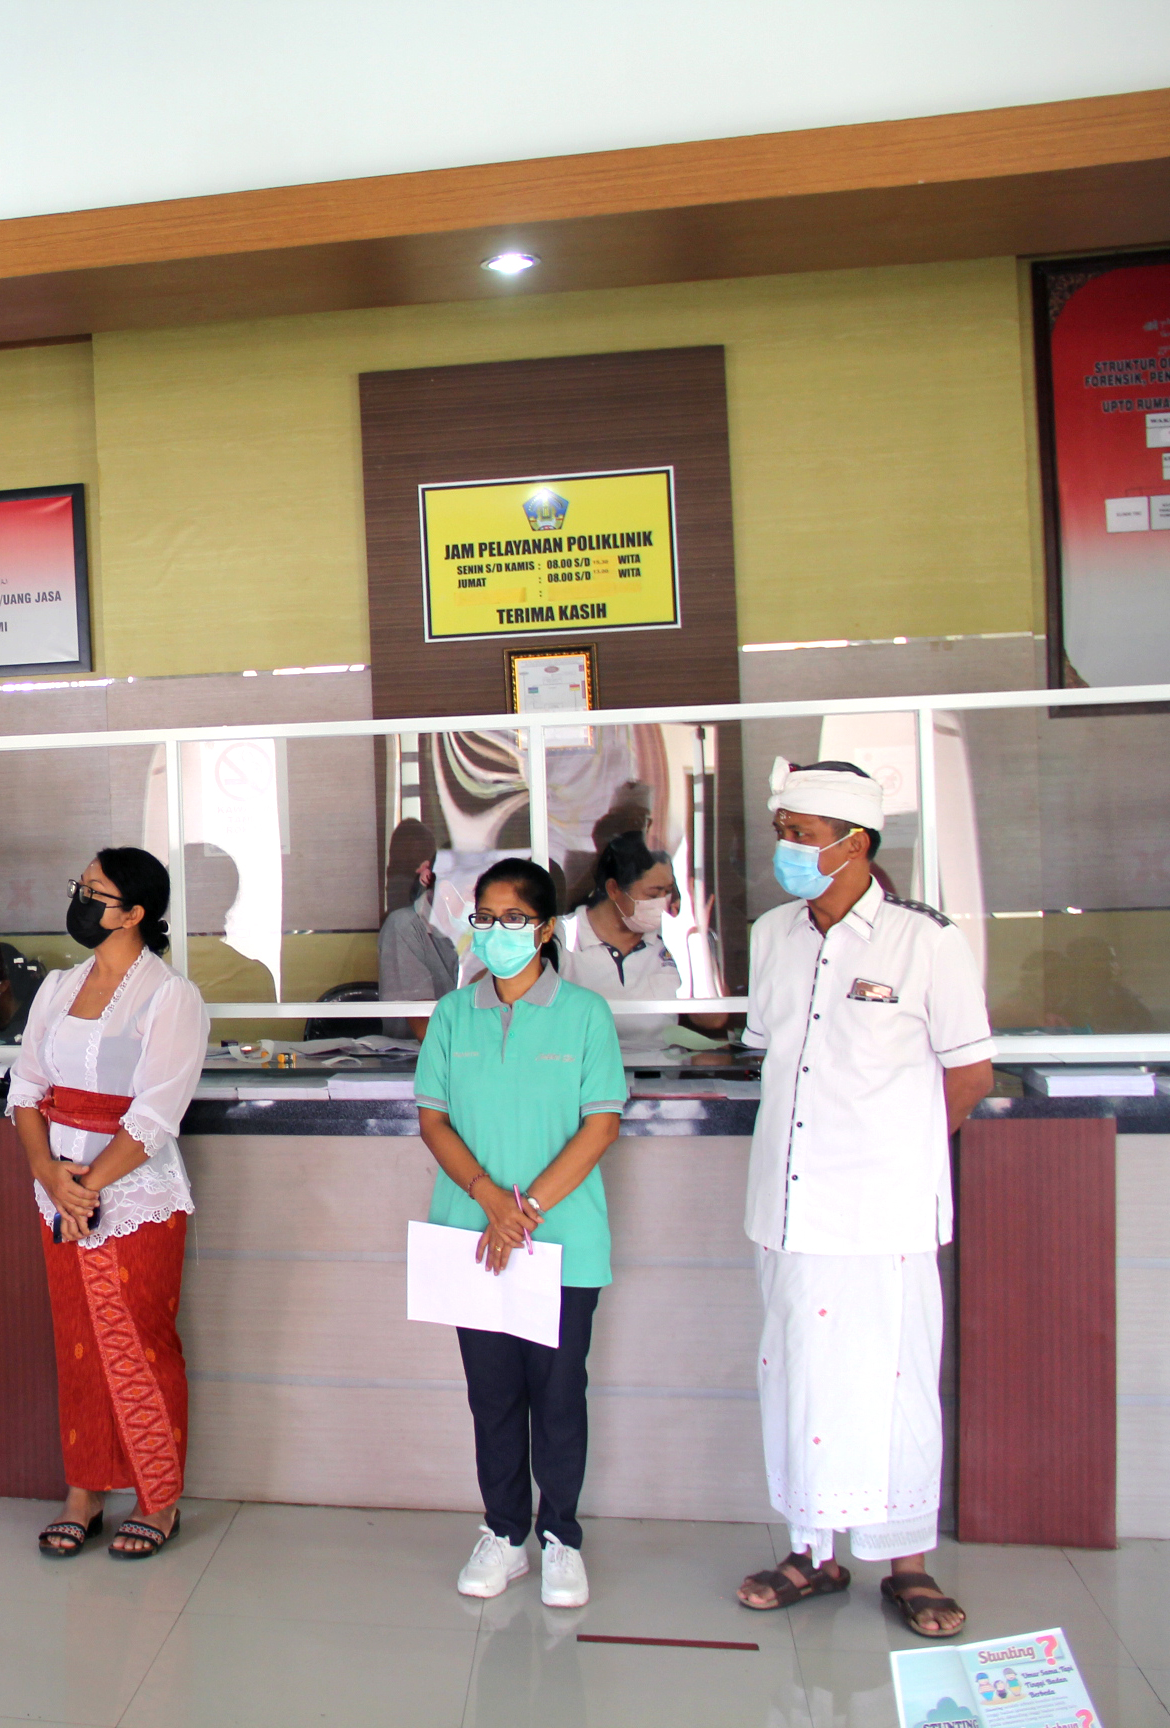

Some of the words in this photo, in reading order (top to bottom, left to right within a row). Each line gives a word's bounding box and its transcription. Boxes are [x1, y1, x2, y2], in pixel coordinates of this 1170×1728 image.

[1095, 358, 1156, 373] STRUKTUR
[1160, 357, 1170, 369] O
[1084, 373, 1147, 388] FORENSIK,
[1102, 399, 1134, 413] UPTD
[444, 543, 474, 560] JAM
[478, 537, 563, 558] PELAYANAN
[567, 531, 653, 552] POLIKLINIK
[457, 565, 483, 575] SENIN
[485, 563, 503, 573] S/D
[505, 561, 535, 572] KAMIS
[547, 559, 572, 569] 08.00
[574, 558, 590, 567] S/D
[618, 554, 641, 564] WITA
[458, 578, 486, 588] JUMAT
[548, 572, 573, 583] 08.00
[575, 571, 591, 581] S/D
[618, 568, 641, 578] WITA
[35, 590, 62, 603] JASA
[496, 606, 555, 624] TERIMA
[558, 603, 607, 621] KASIH
[978, 1646, 1036, 1664] Stunting
